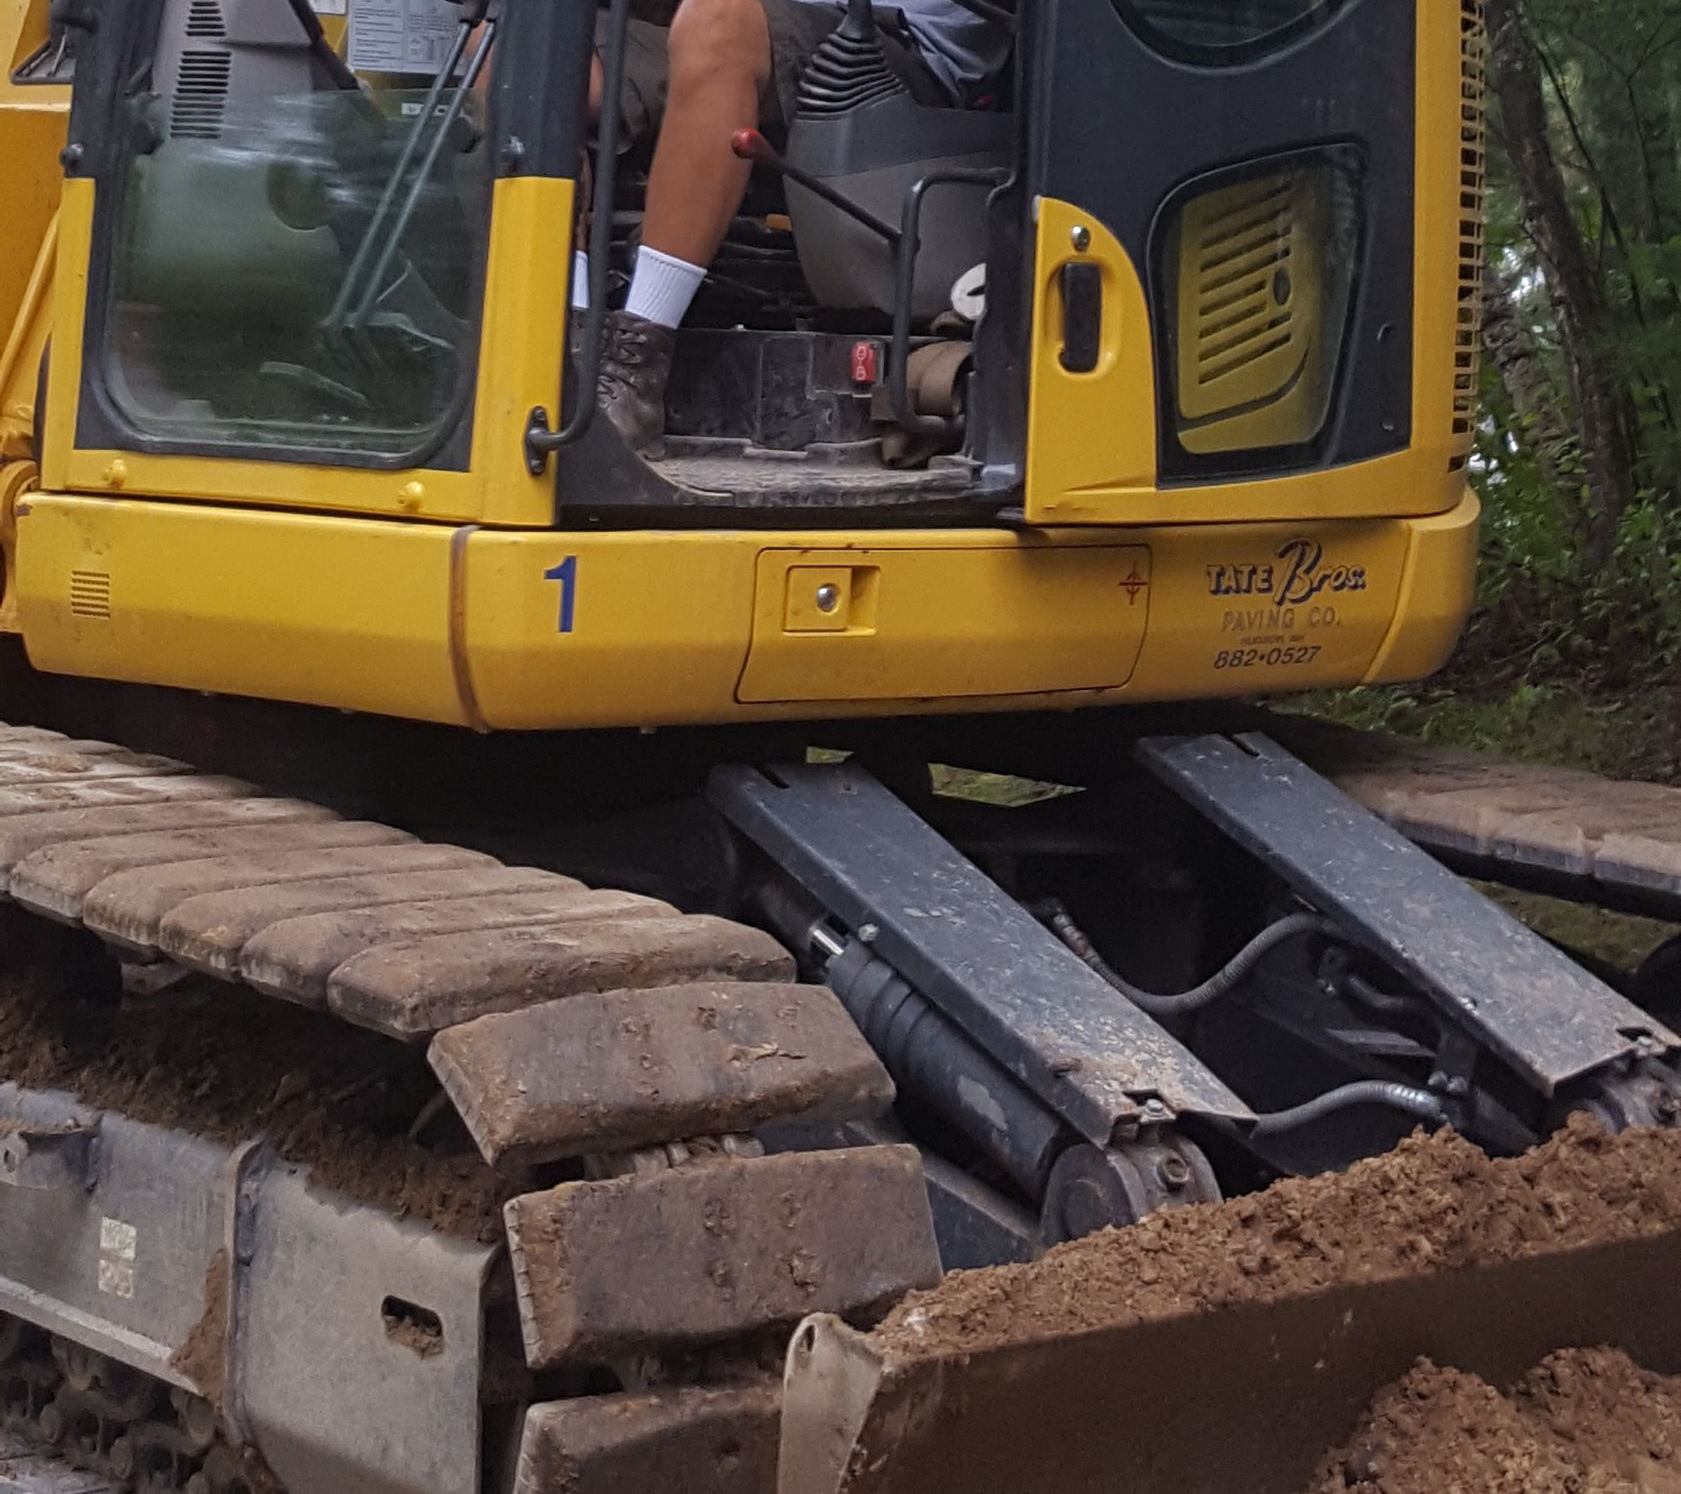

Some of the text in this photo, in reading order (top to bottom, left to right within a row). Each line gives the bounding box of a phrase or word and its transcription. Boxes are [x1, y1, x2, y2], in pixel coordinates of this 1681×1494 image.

[543, 554, 577, 633] 1
[1207, 563, 1274, 596] TATE
[1221, 608, 1296, 633] PAVING
